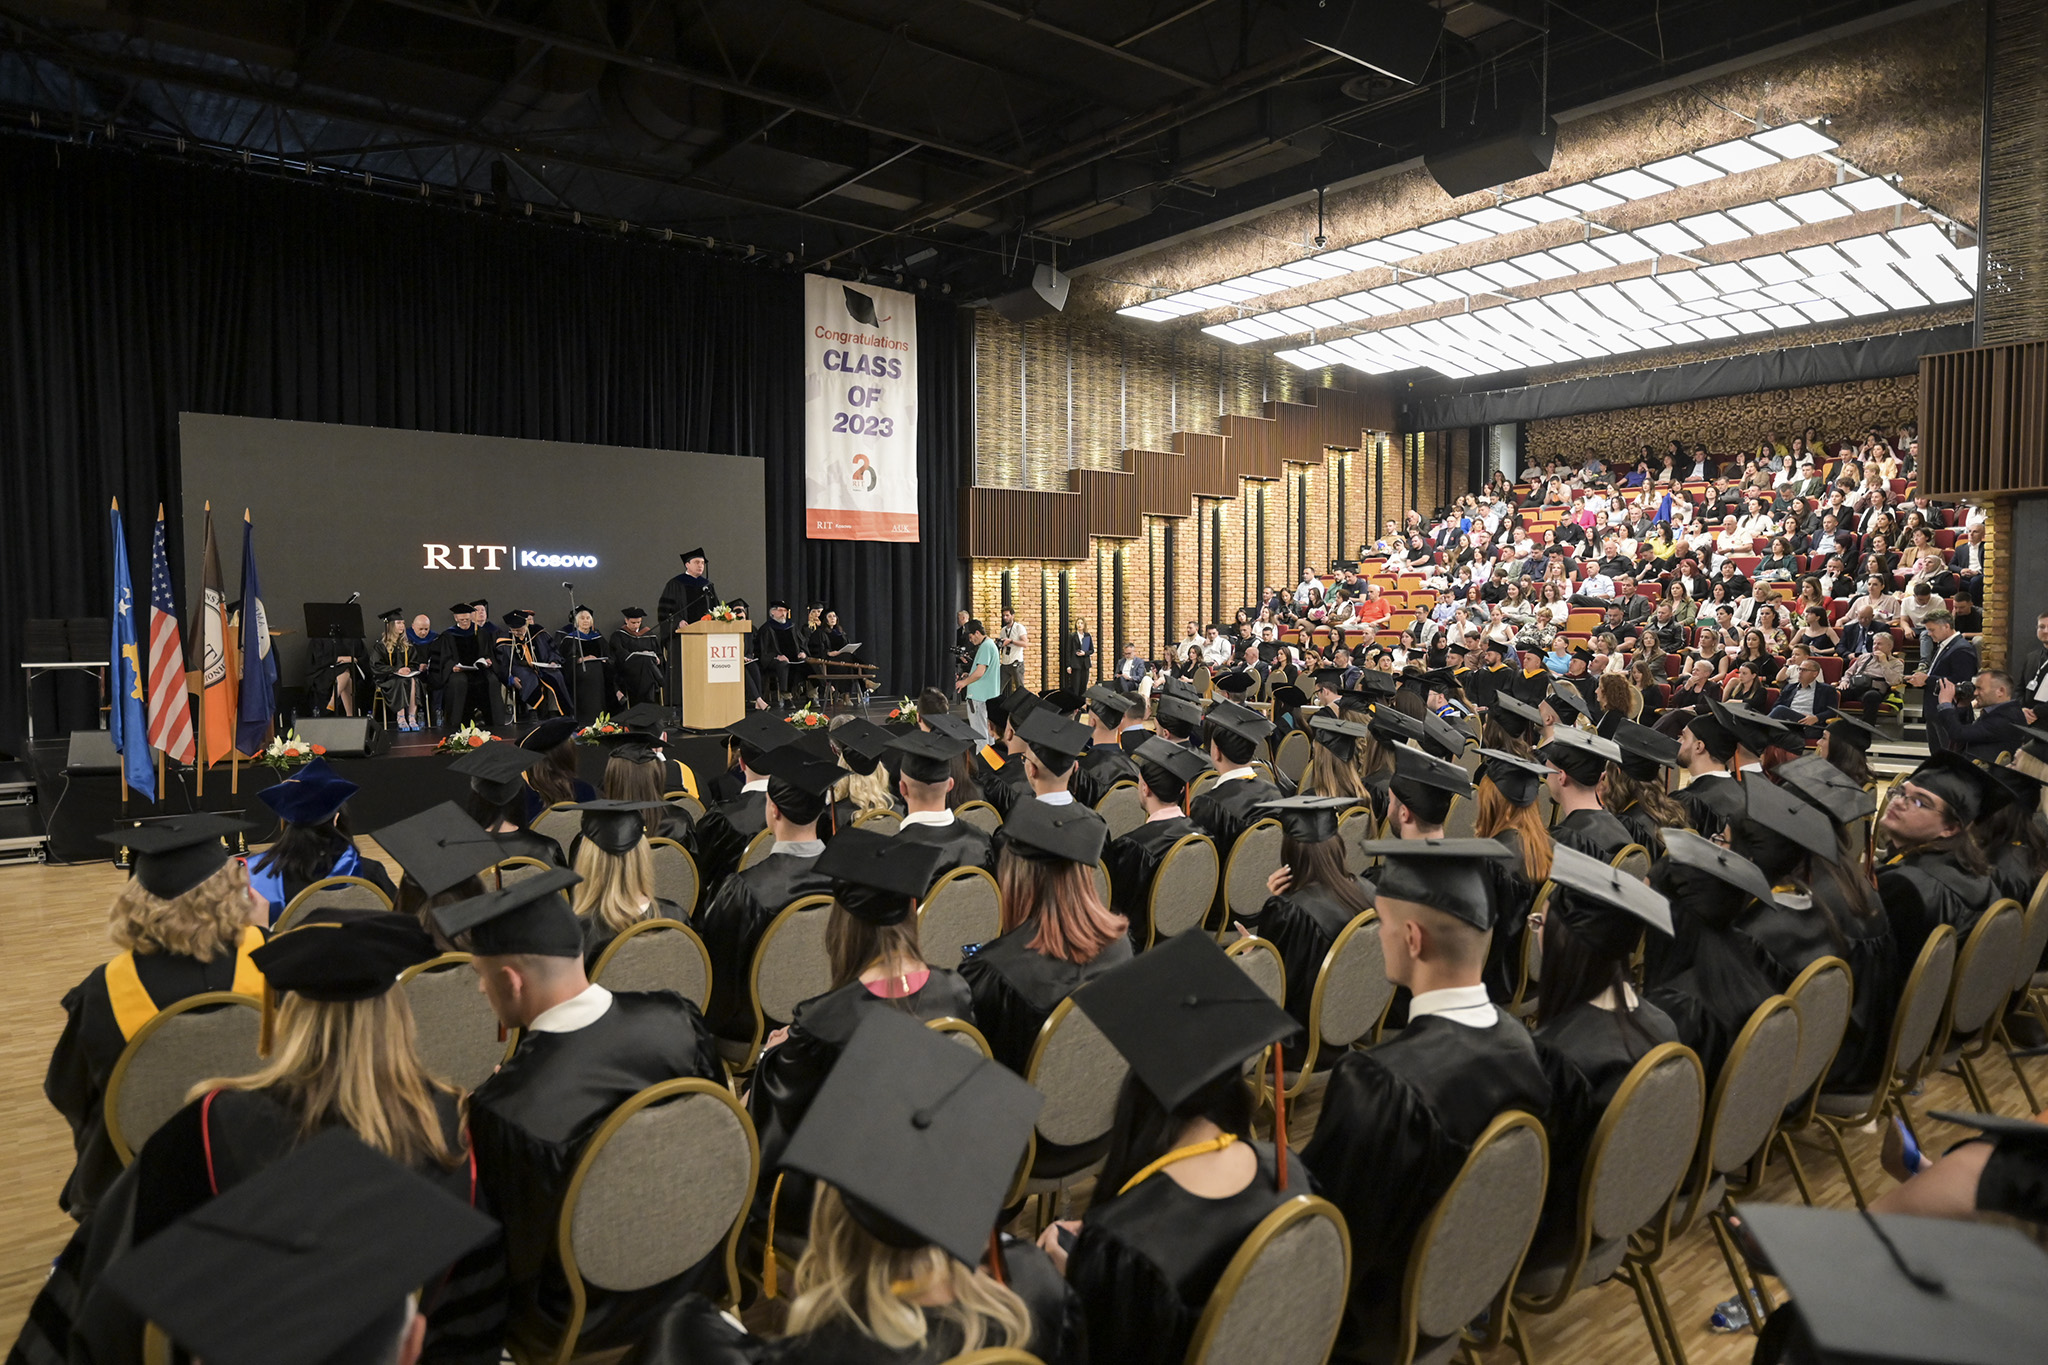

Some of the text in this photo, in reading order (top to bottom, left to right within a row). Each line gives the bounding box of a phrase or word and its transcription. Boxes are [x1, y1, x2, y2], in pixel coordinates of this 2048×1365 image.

[815, 326, 909, 351] Congratulations
[823, 349, 902, 379] CLASS
[847, 385, 881, 408] OF
[832, 412, 894, 437] 2023
[816, 521, 833, 530] RIT
[423, 544, 598, 570] RIT Kosovo
[711, 646, 737, 658] RIT
